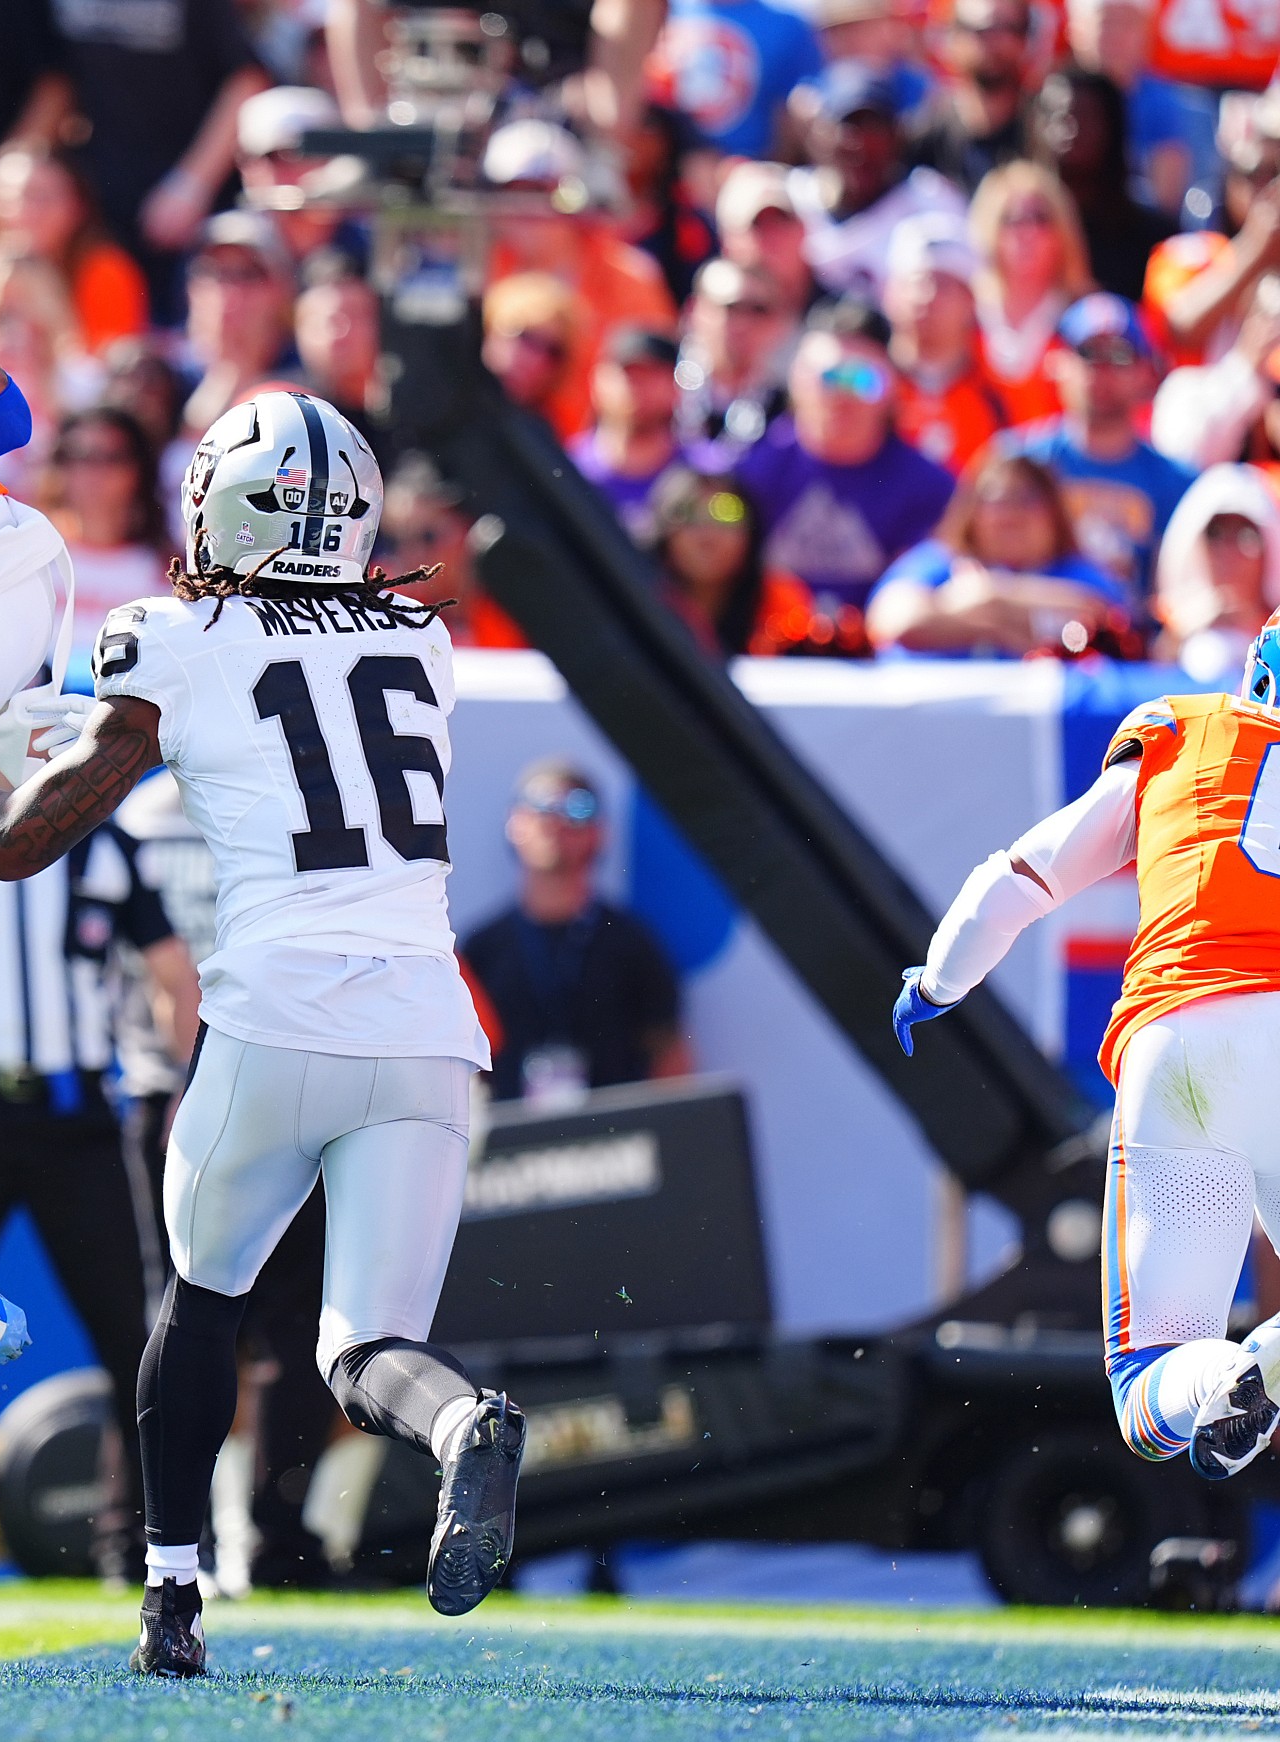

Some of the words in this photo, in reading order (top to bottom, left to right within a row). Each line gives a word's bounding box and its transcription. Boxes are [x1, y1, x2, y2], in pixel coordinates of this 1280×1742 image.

[332, 495, 346, 507] AL
[272, 560, 341, 578] RAIDERS
[248, 653, 452, 877] 16
